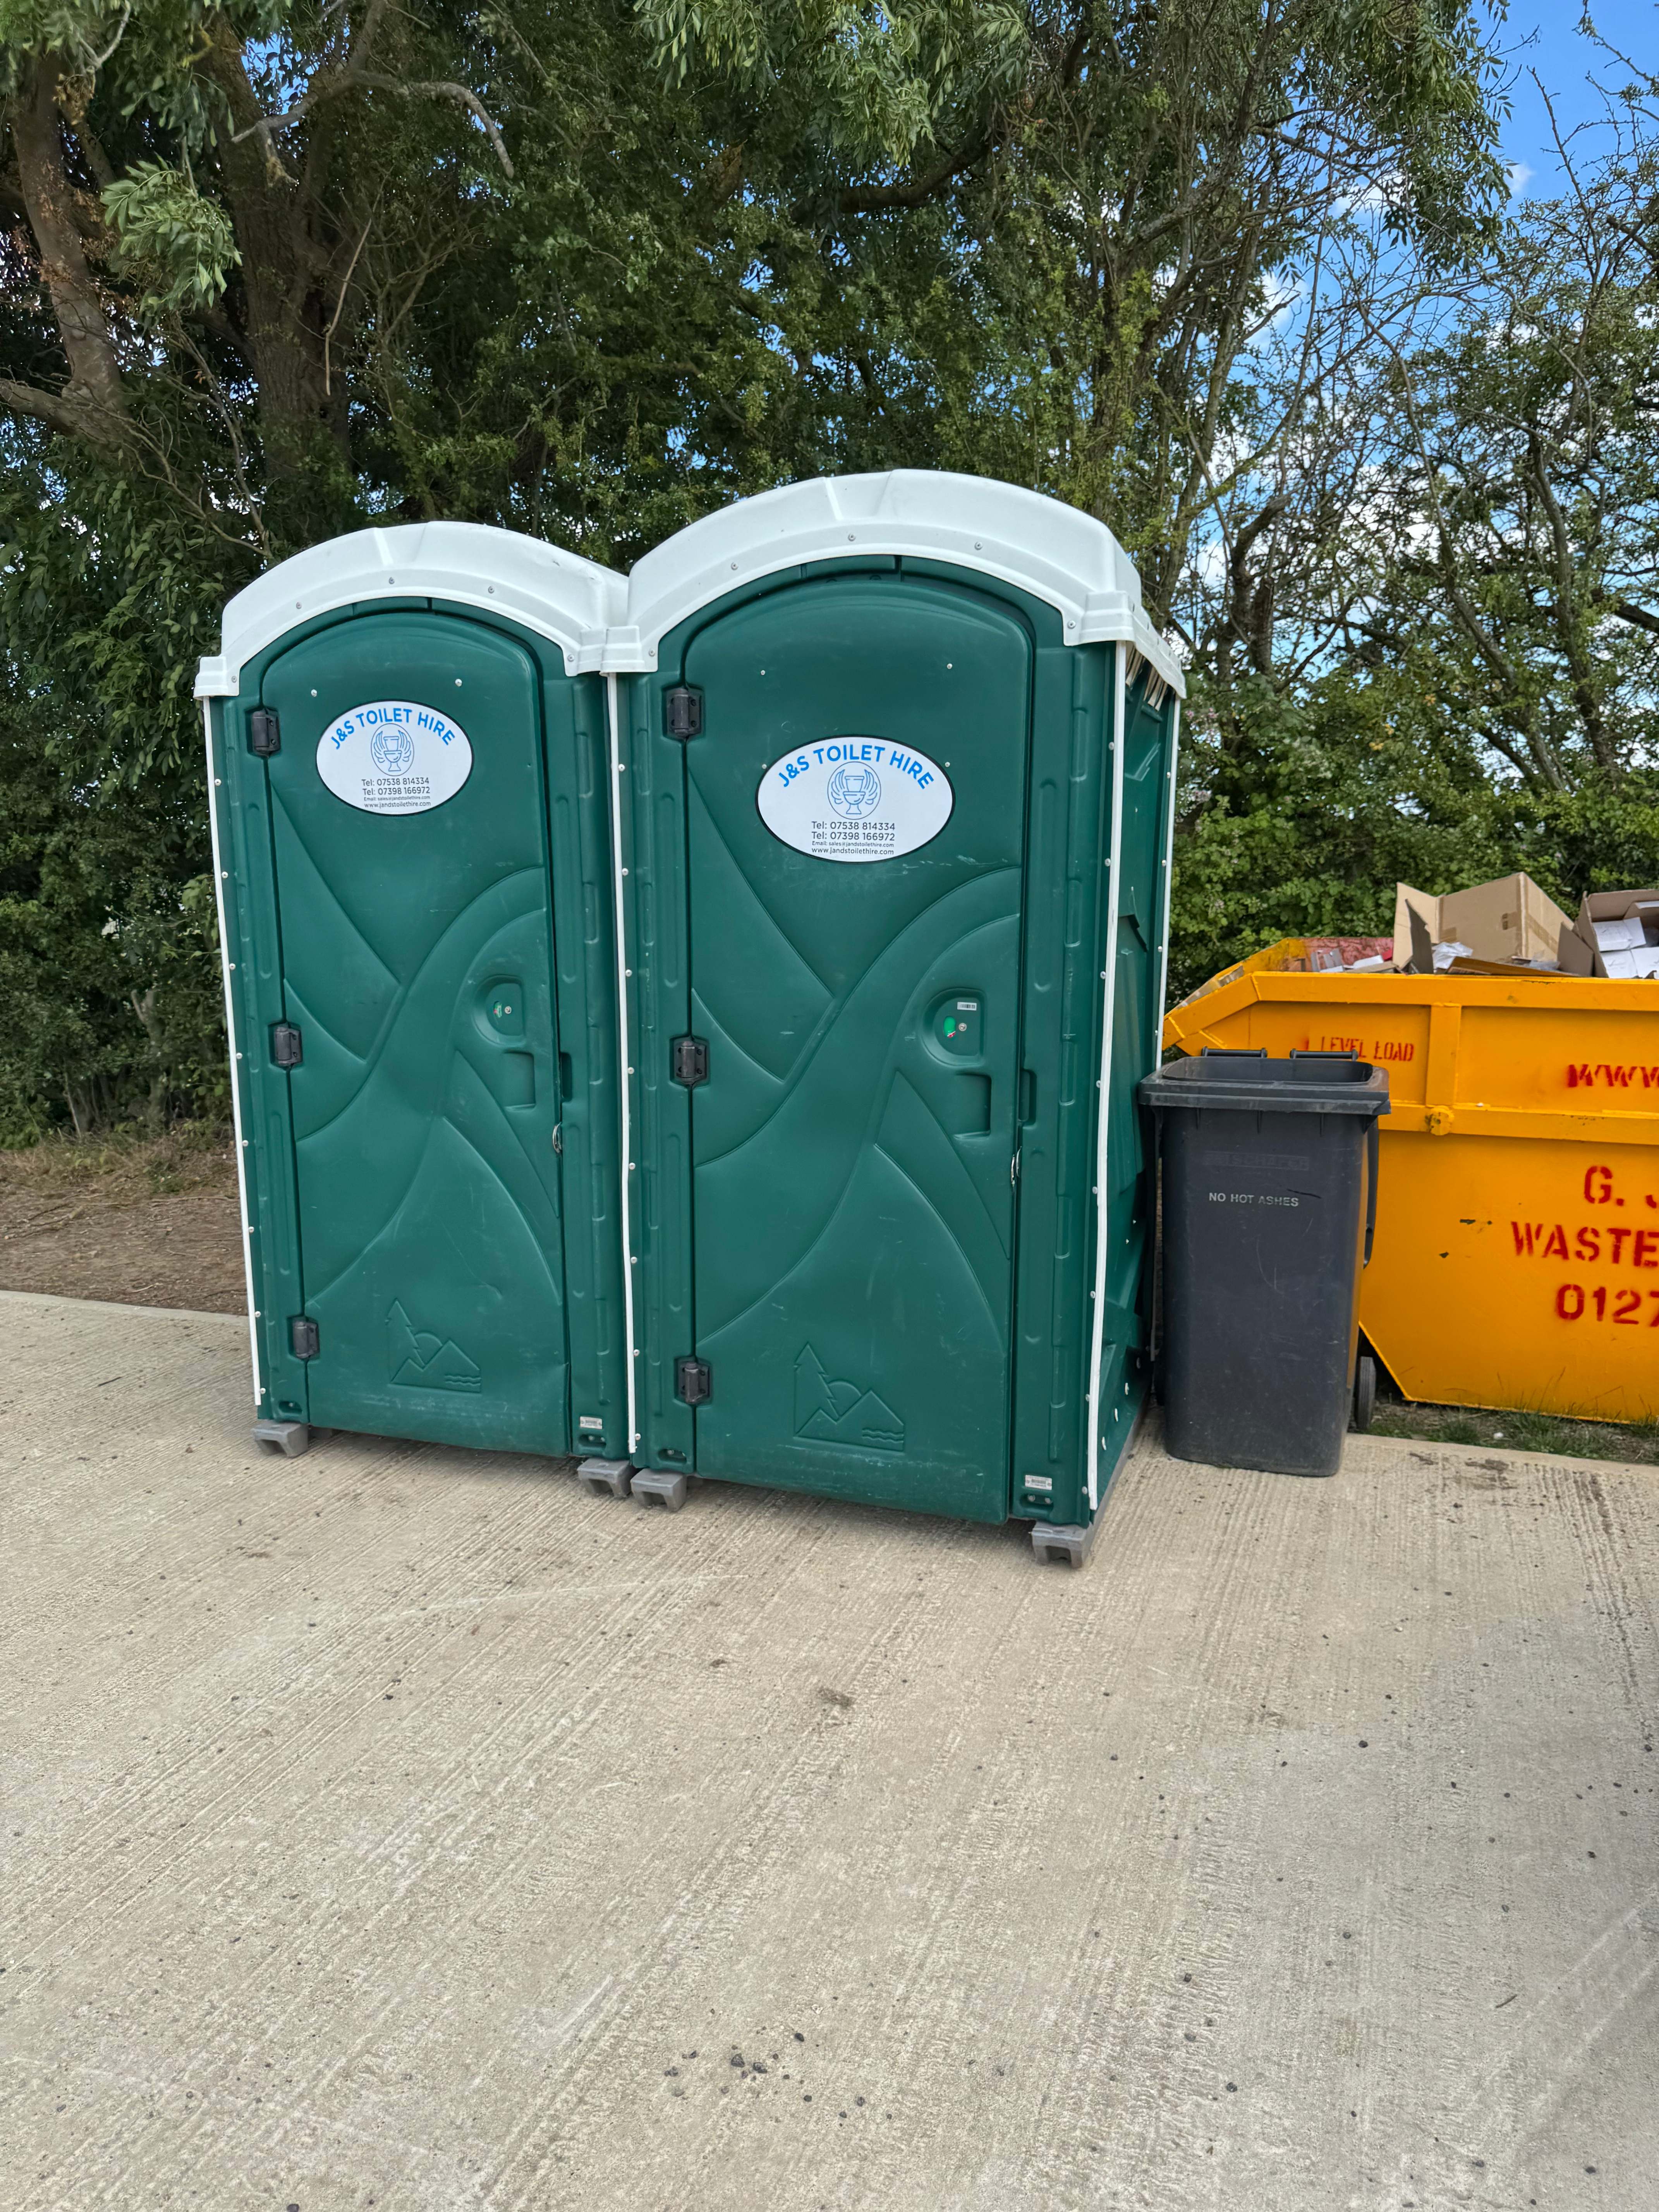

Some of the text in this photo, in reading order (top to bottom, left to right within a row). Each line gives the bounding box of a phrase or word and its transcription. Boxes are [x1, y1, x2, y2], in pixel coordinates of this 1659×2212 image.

[331, 708, 455, 750] J&S TOILET HIRE
[778, 744, 934, 790] J&S TOILET HIRE
[812, 821, 827, 829] Tel:
[862, 822, 895, 830] 814334
[830, 832, 859, 840] 07398
[862, 833, 895, 841] 166972
[812, 847, 894, 855] www.jandstoilethire.com
[1374, 1041, 1415, 1062] LOAD
[1584, 1166, 1625, 1207] G.
[1209, 1192, 1299, 1207] NO HOT ASHES
[1511, 1221, 1659, 1268] WASTE
